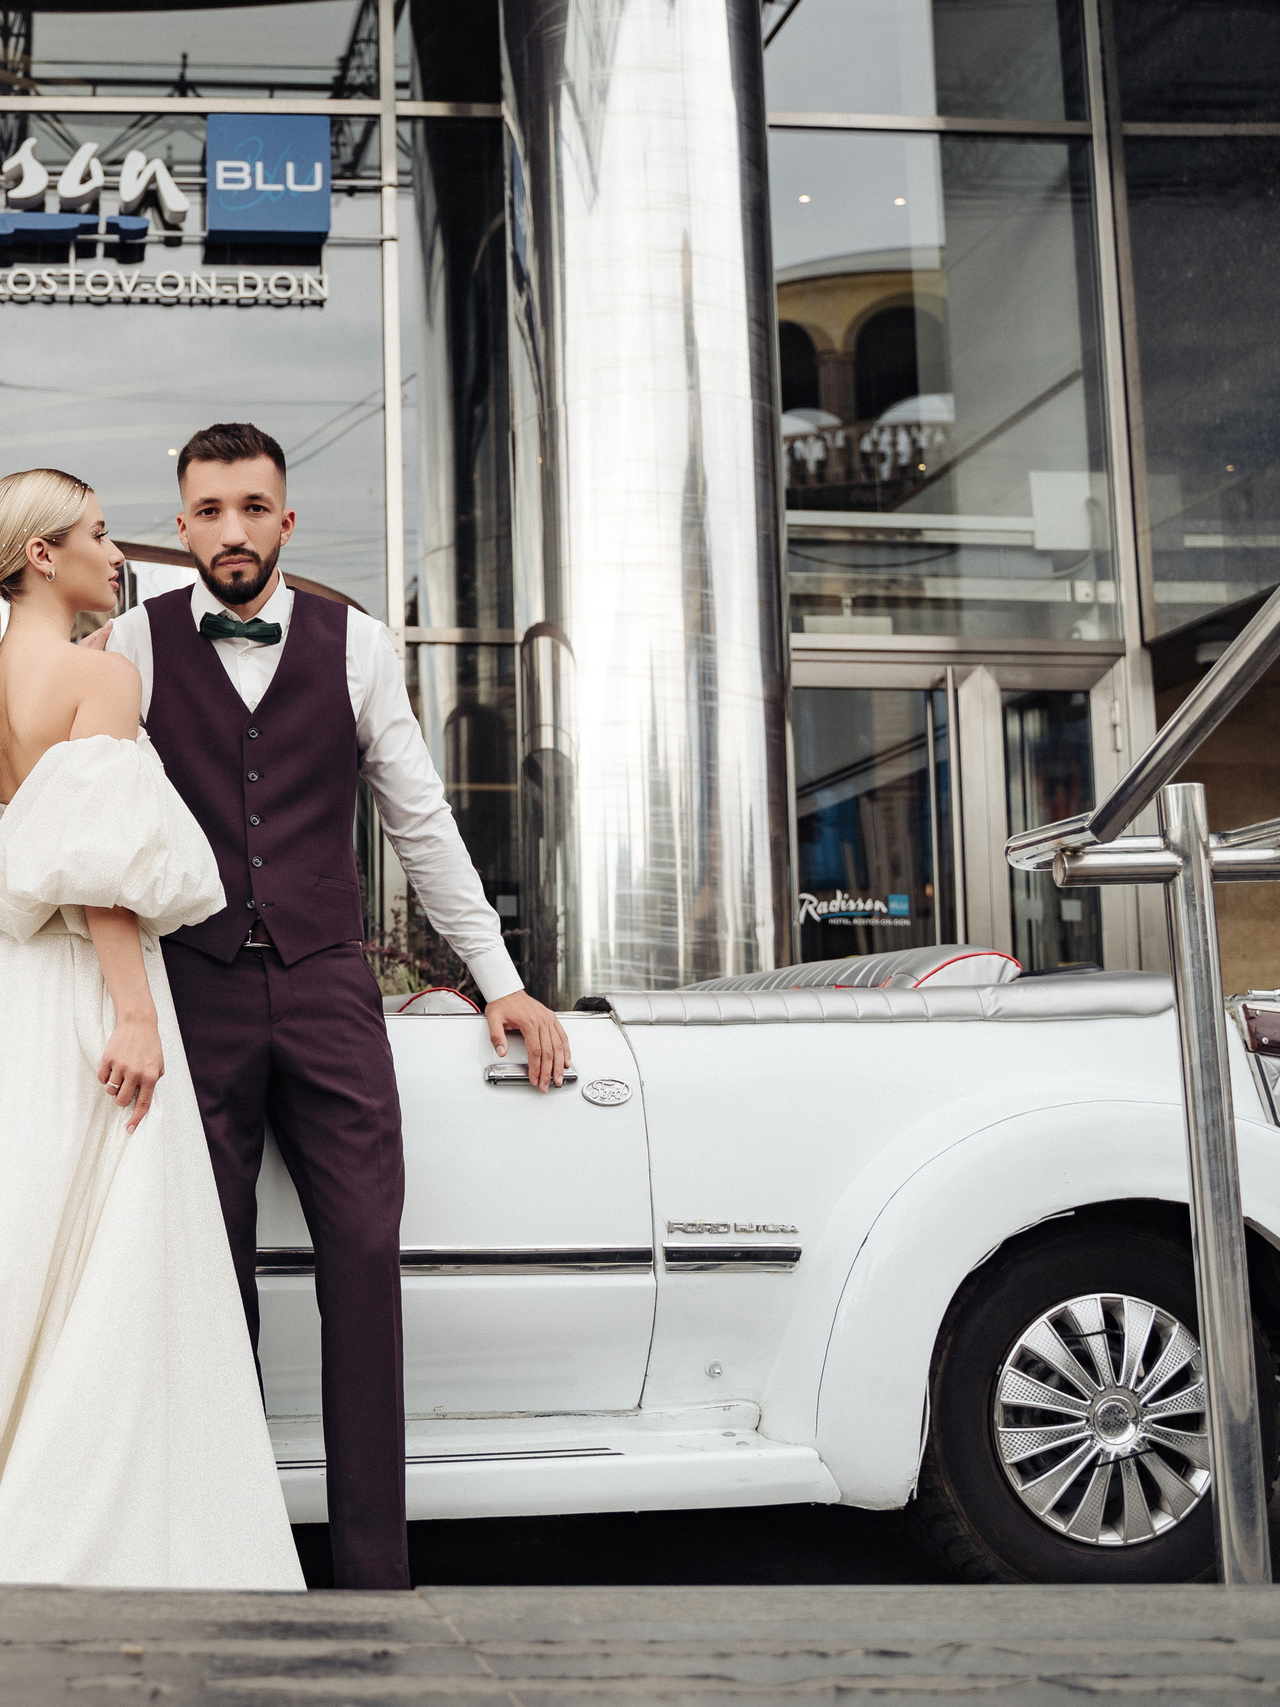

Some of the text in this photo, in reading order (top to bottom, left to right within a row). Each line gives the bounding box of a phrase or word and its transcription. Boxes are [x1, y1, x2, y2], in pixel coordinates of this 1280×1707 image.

[215, 160, 323, 192] BLU
[799, 889, 888, 925] Radisson
[588, 1080, 628, 1101] Ford
[667, 1220, 731, 1235] FORD
